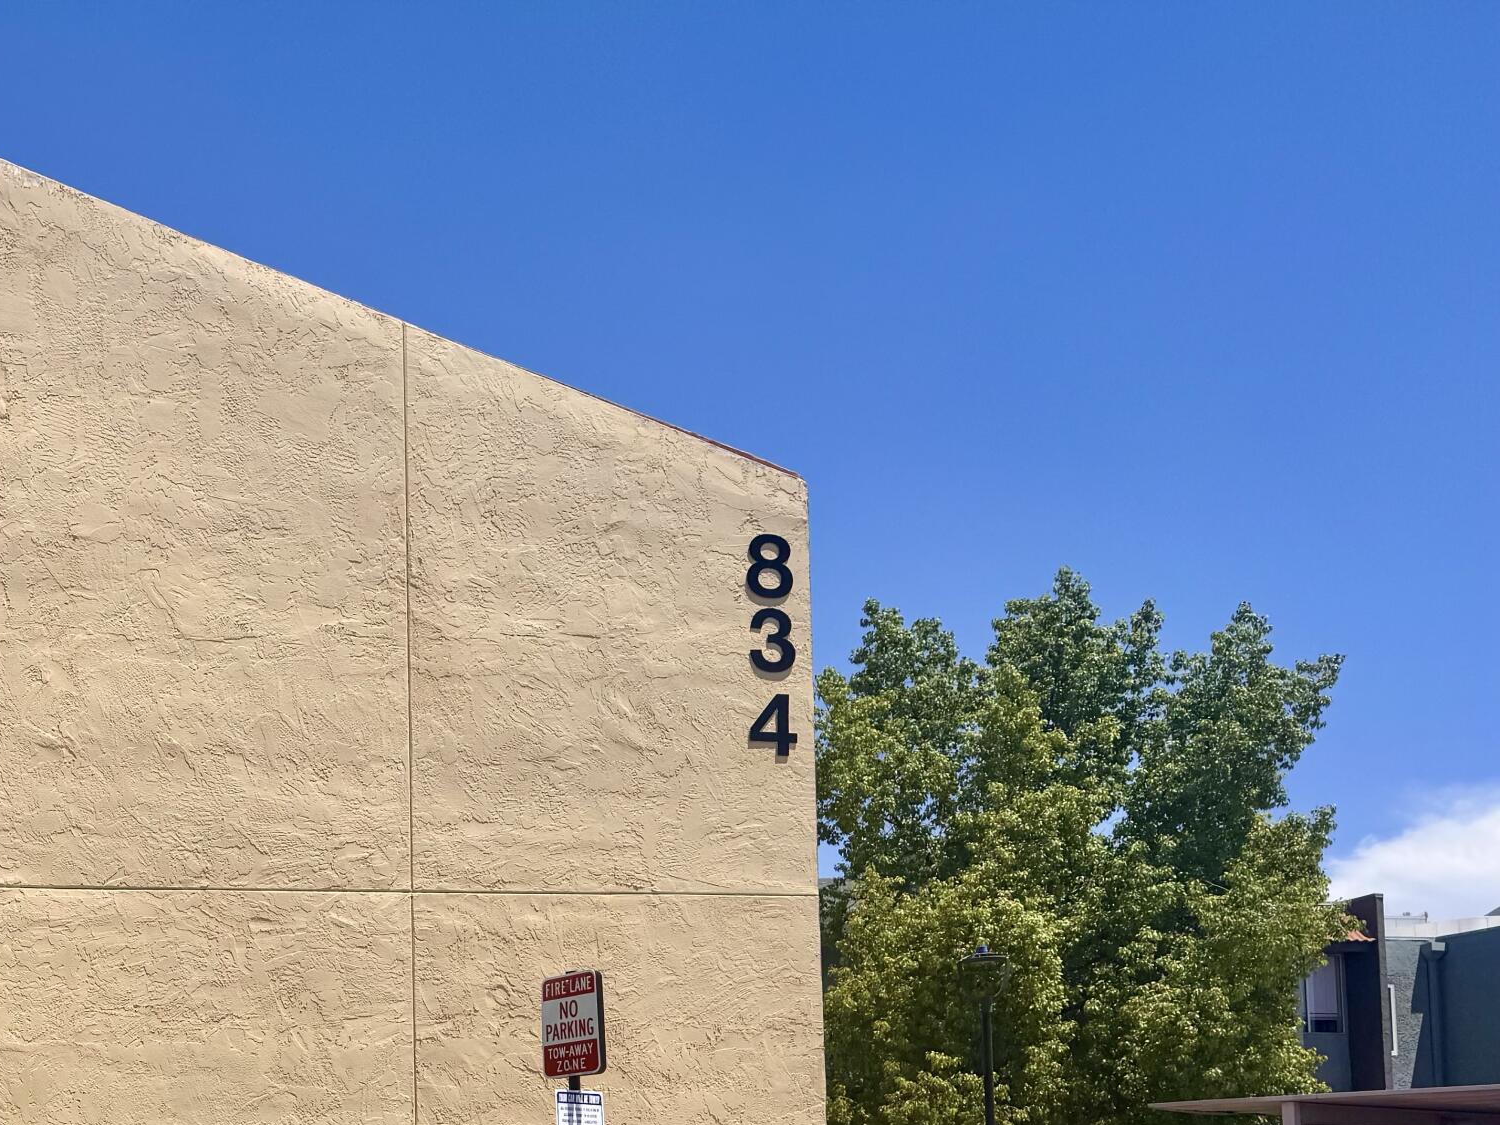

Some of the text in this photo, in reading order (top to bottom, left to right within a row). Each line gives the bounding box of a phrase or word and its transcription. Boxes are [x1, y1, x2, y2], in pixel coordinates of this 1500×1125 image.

[746, 534, 798, 757] 834
[545, 975, 592, 998] FIRE LANE
[559, 999, 578, 1020] NO
[545, 1017, 595, 1042] PARKING
[548, 1042, 593, 1060] TOW-AWAY
[556, 1057, 587, 1073] ZONE
